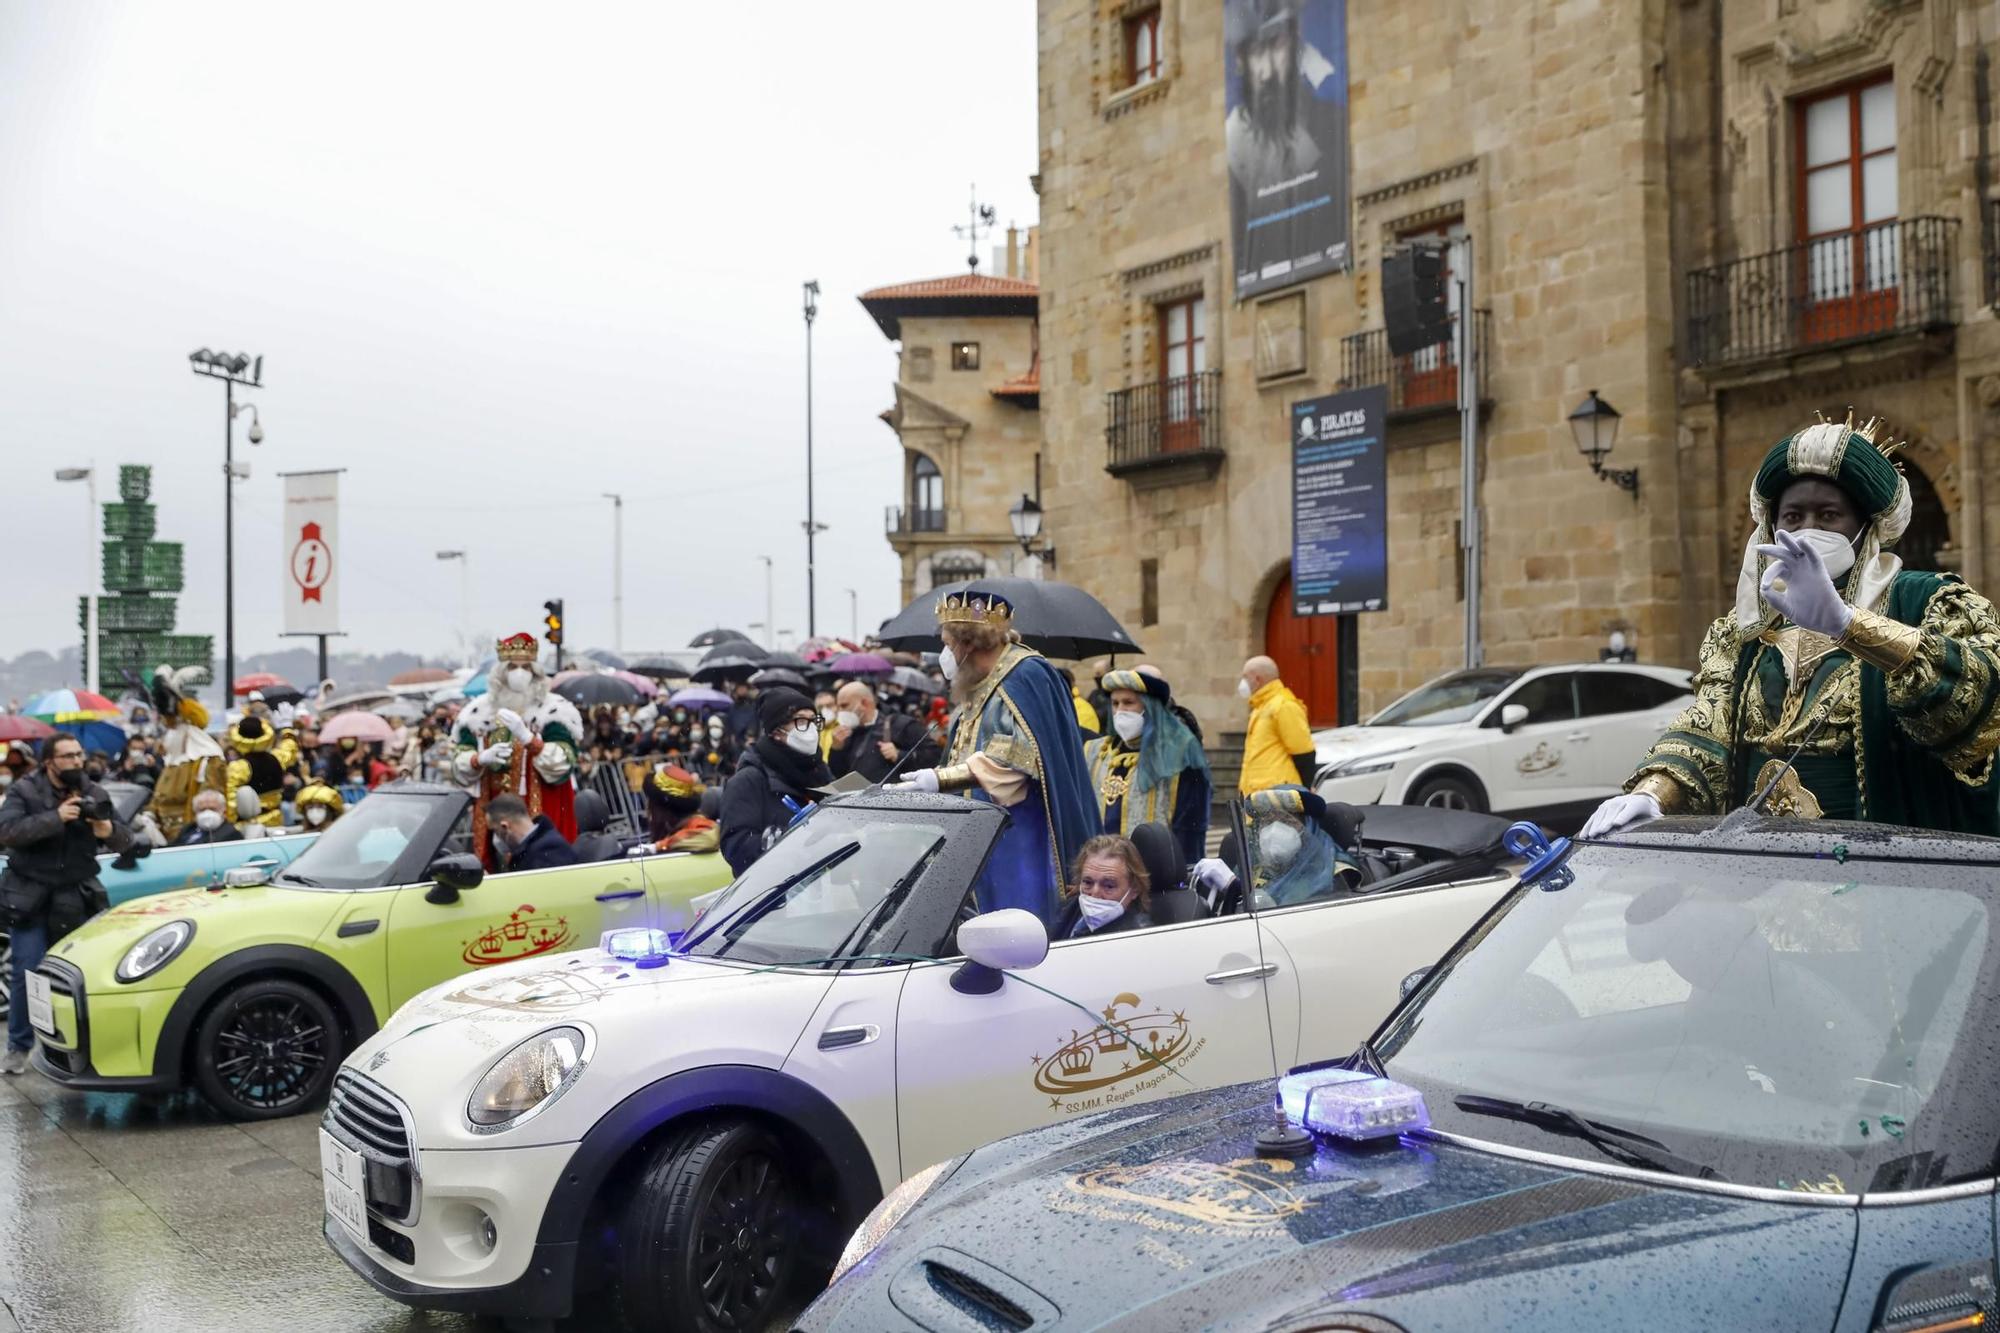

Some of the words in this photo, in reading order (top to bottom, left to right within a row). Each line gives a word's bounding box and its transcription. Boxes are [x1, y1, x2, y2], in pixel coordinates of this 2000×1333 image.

[1320, 408, 1366, 432] PIRATAS
[1066, 1098, 1104, 1114] SS.MM.
[1106, 1088, 1135, 1106] Reyes
[1135, 1073, 1167, 1094] Magos
[1178, 1036, 1207, 1068] Oriente
[1129, 1210, 1183, 1232] Magos
[1184, 1222, 1206, 1234] de
